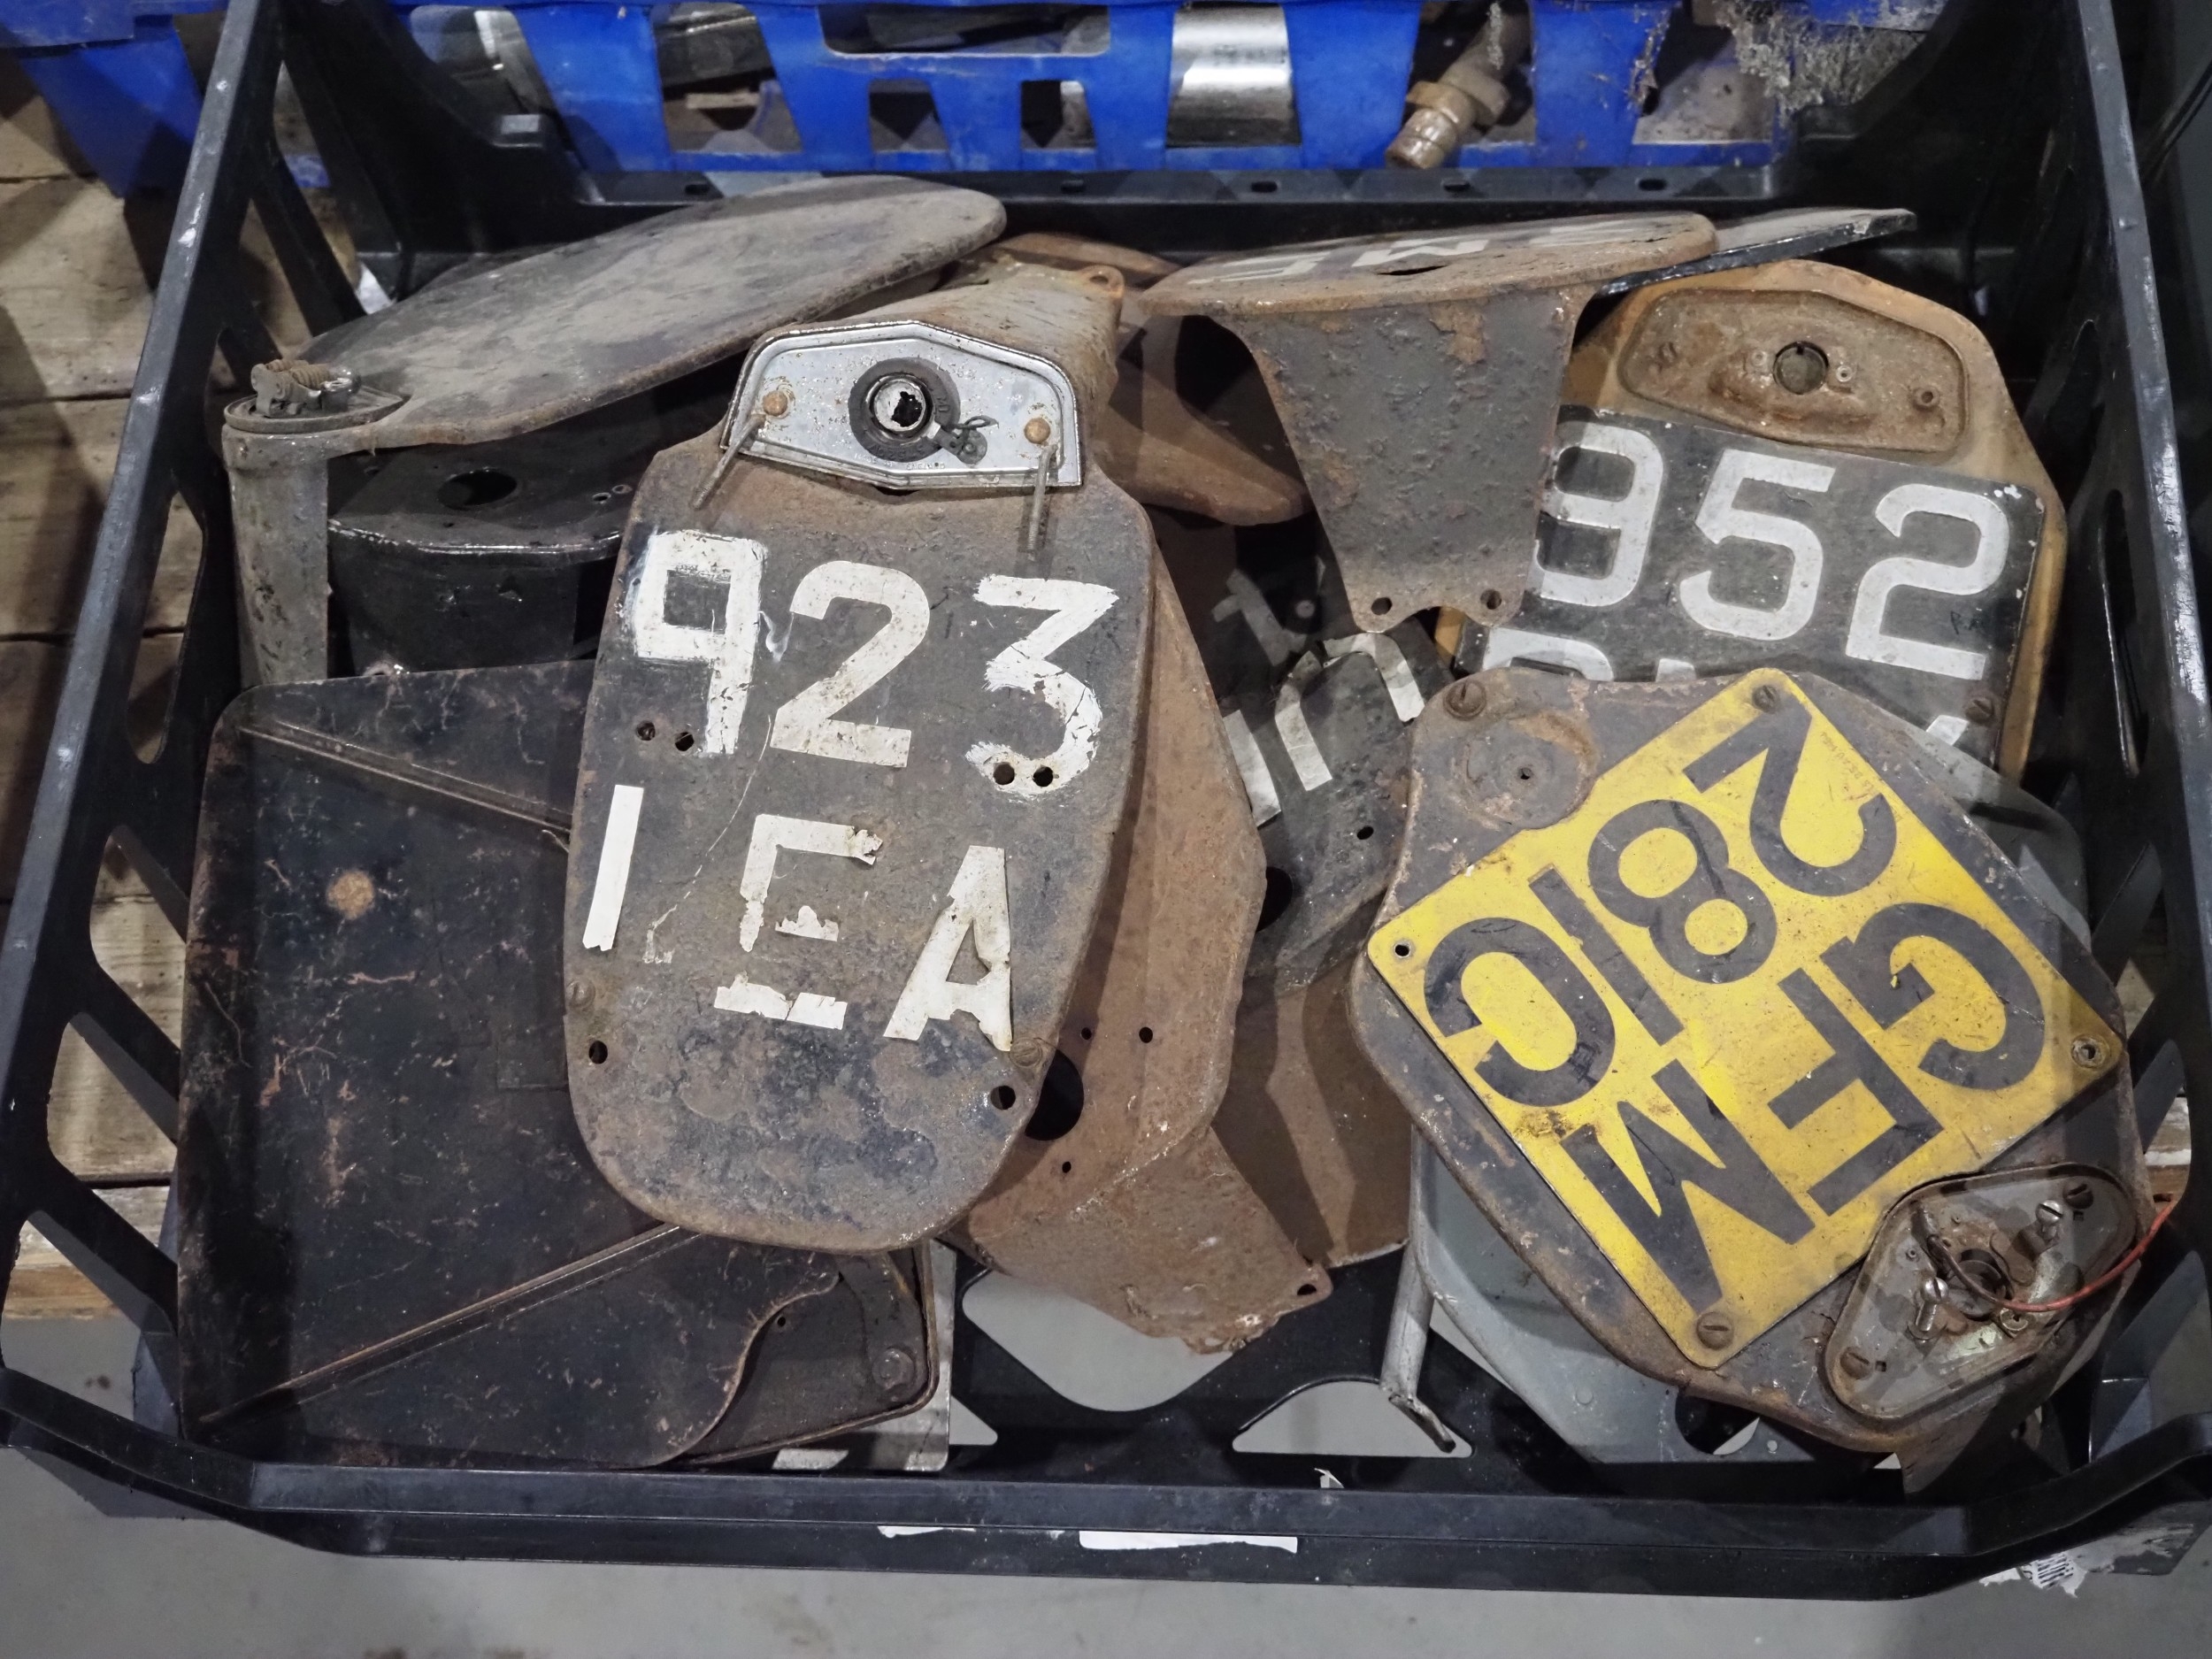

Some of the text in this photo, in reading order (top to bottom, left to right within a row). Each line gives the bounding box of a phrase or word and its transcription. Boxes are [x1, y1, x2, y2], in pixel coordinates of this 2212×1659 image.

[632, 528, 1119, 802] 923
[1534, 420, 2010, 680] 952
[1424, 705, 1898, 1108] 281C
[1562, 902, 2046, 1312] GFM
